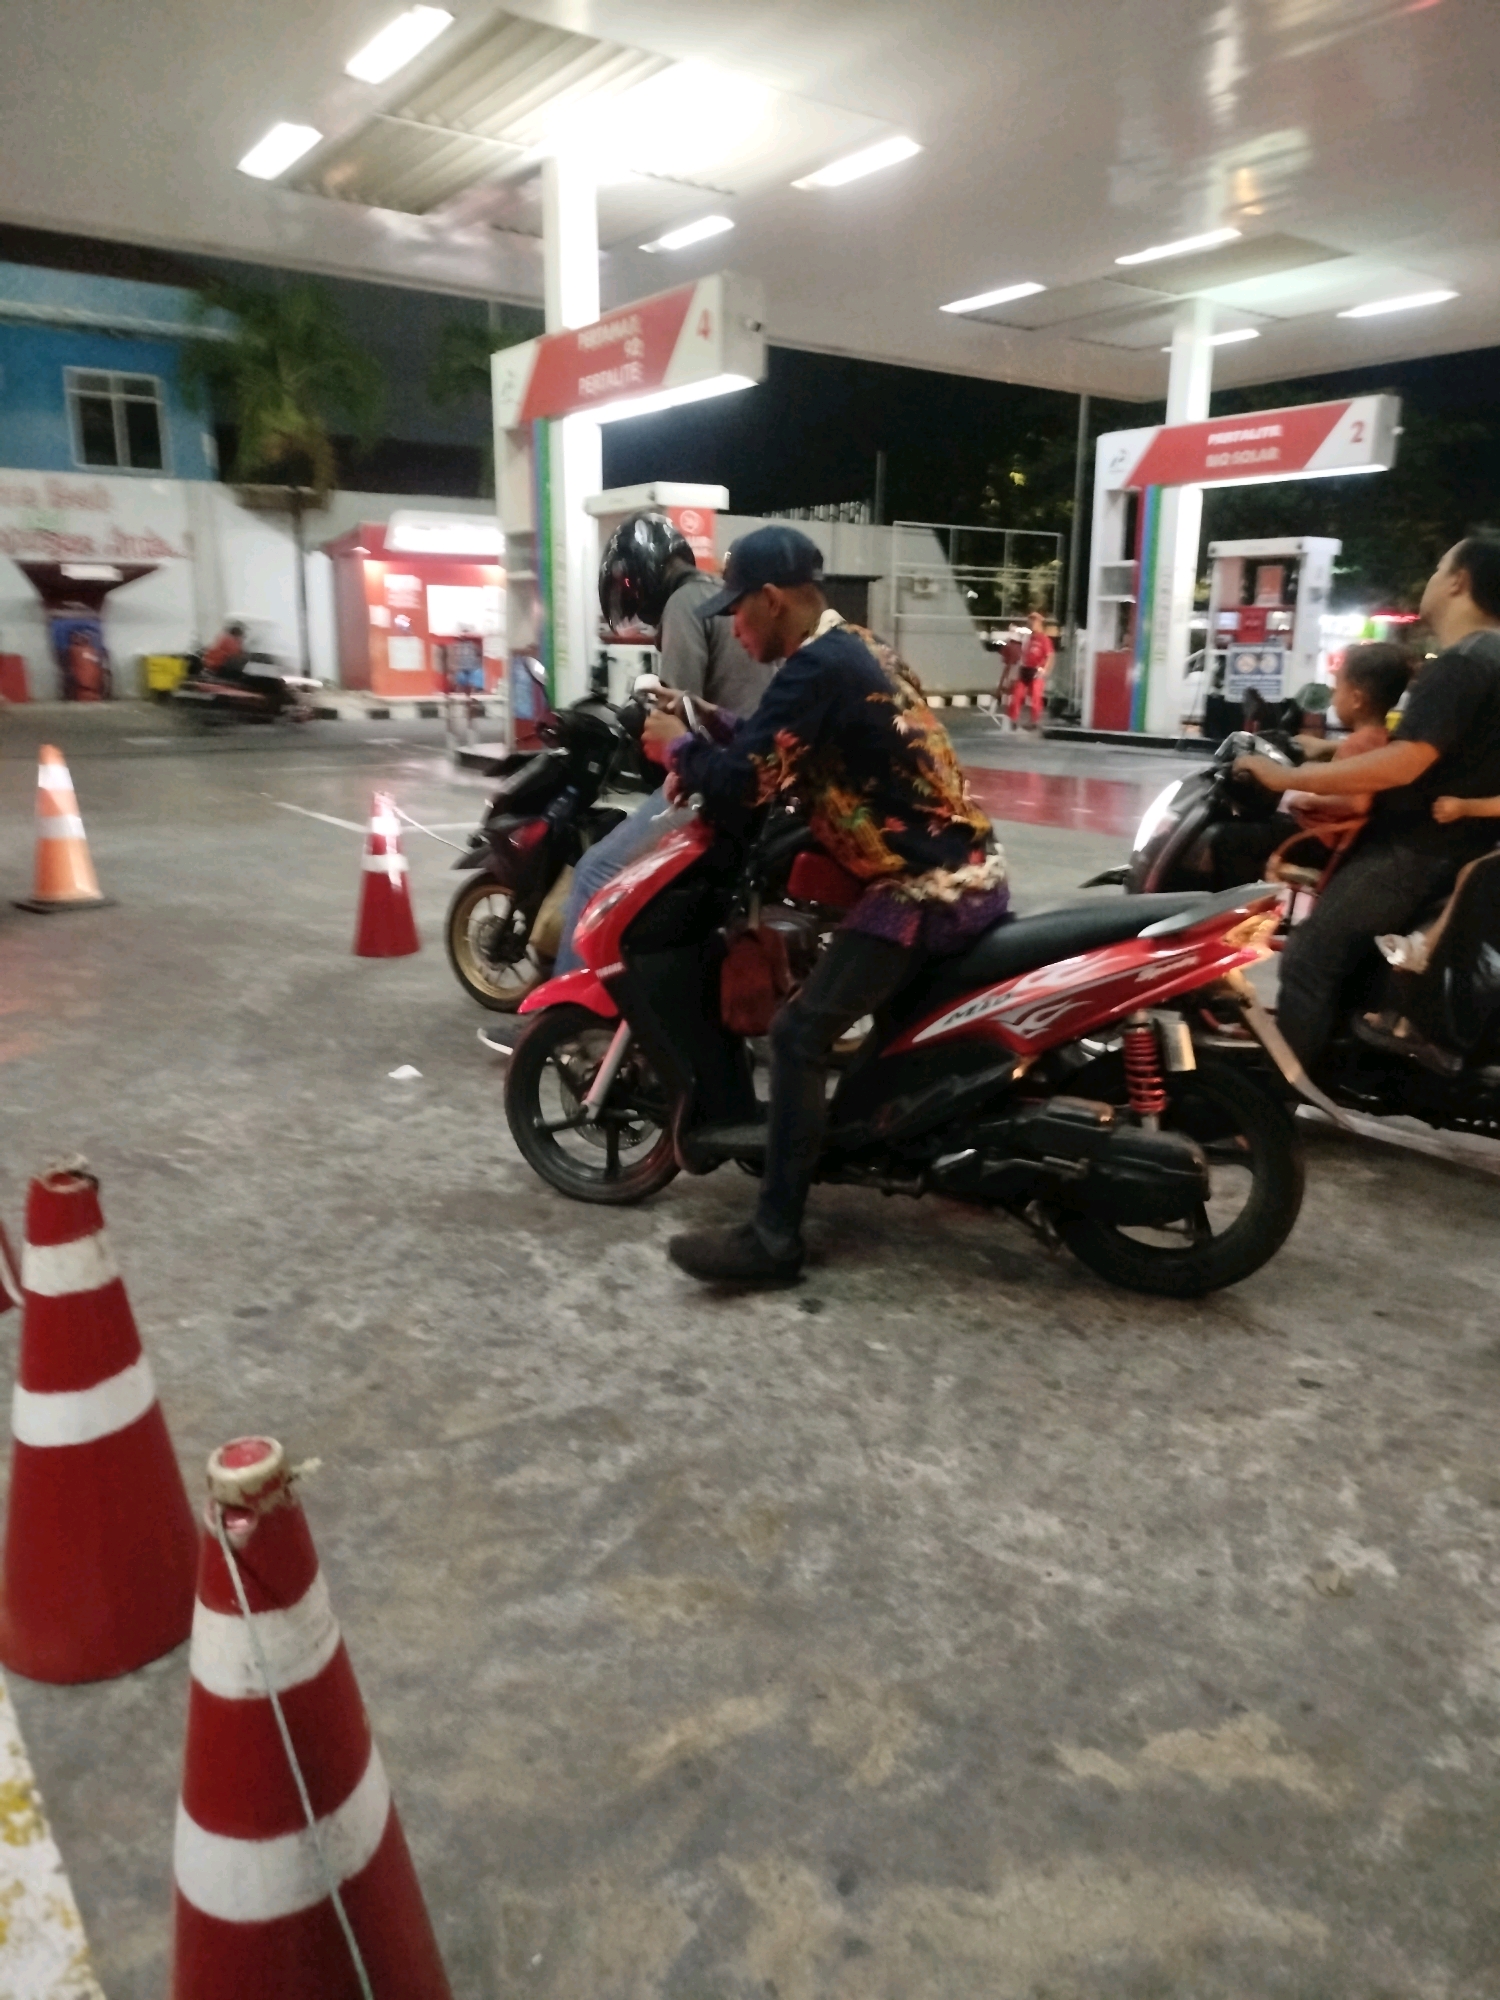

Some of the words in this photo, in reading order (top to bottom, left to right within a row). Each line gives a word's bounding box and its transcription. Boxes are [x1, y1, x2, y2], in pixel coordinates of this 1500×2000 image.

[697, 309, 712, 340] 4
[578, 361, 644, 398] PERTALITE
[1351, 421, 1364, 443] 2
